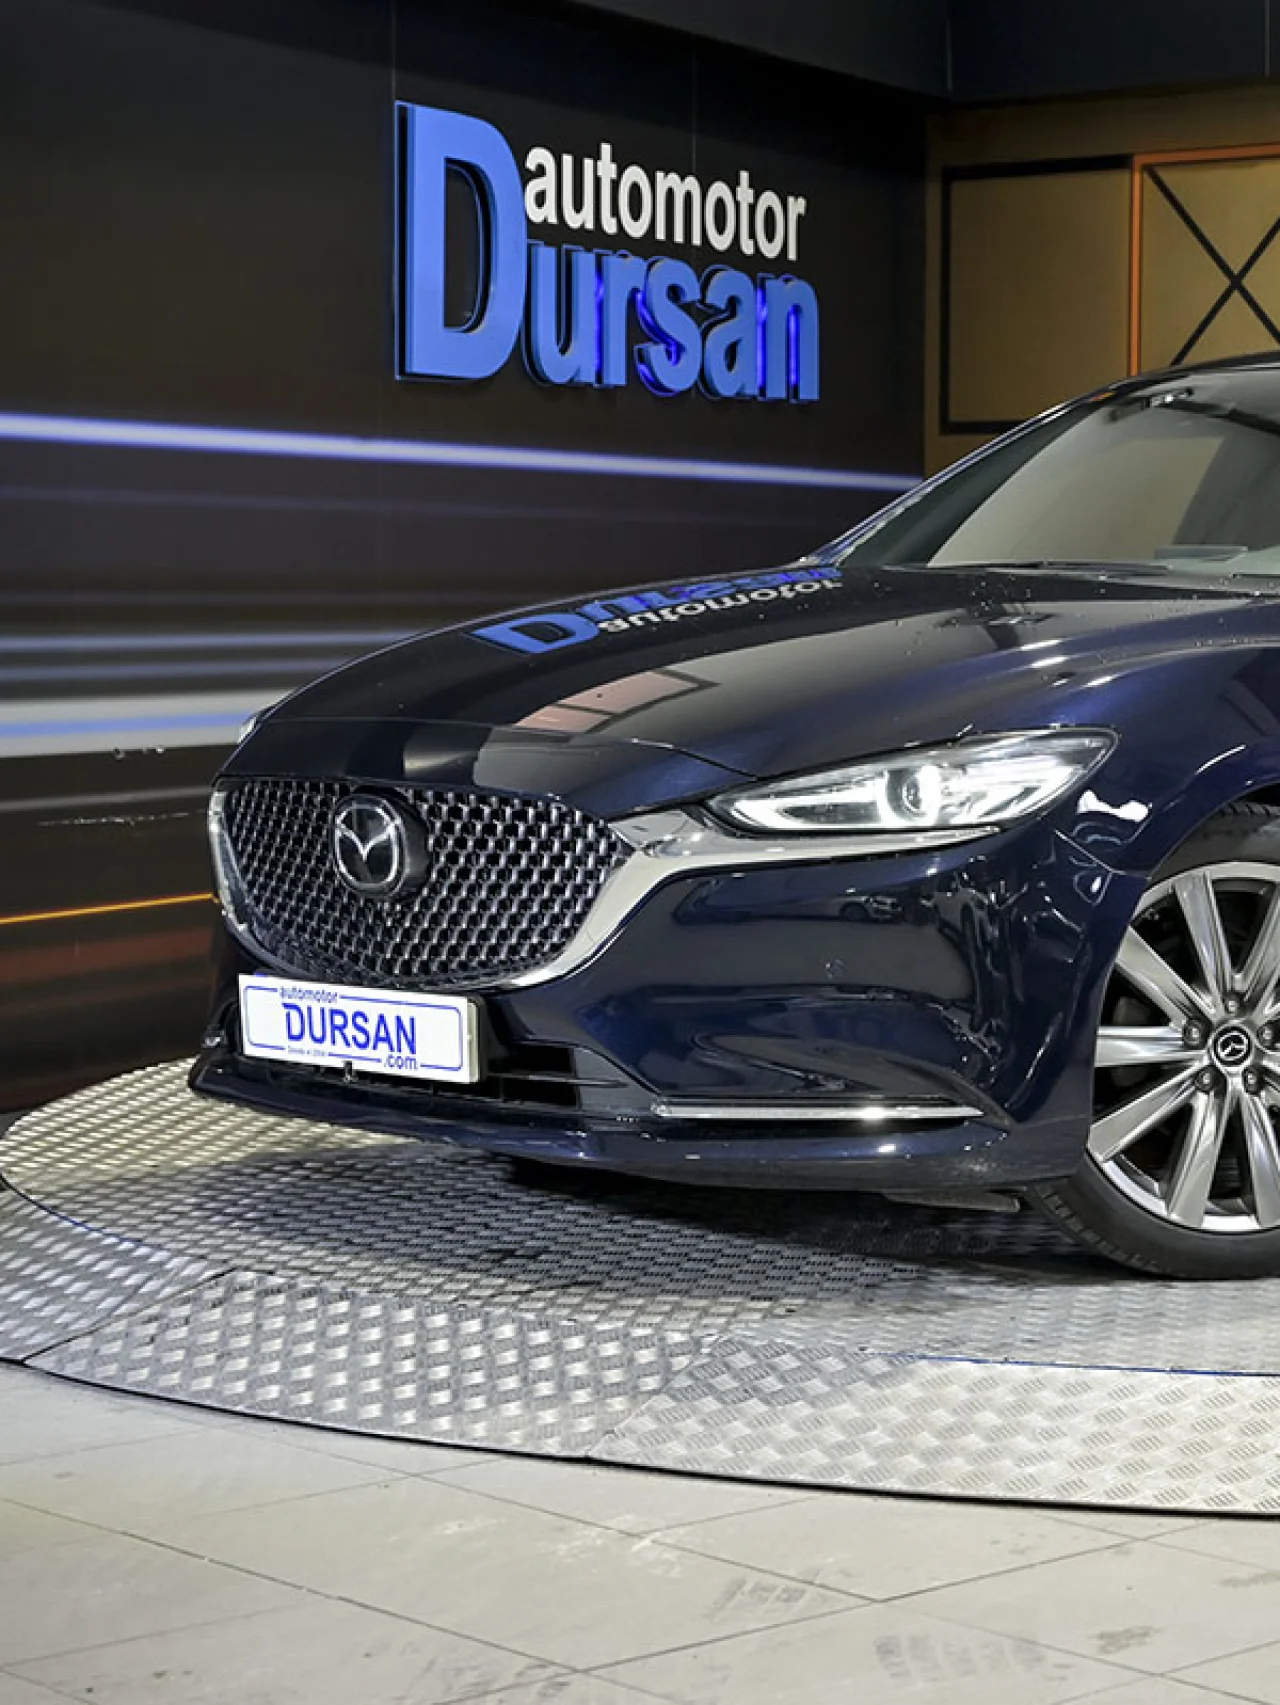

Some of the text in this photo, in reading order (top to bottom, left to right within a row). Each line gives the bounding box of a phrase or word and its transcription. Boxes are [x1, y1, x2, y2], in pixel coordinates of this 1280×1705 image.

[524, 142, 807, 261] automotor
[395, 100, 820, 402] Dursan
[279, 985, 338, 1004] automotor
[282, 1002, 417, 1055] DURSAN
[383, 1054, 419, 1071] .com
